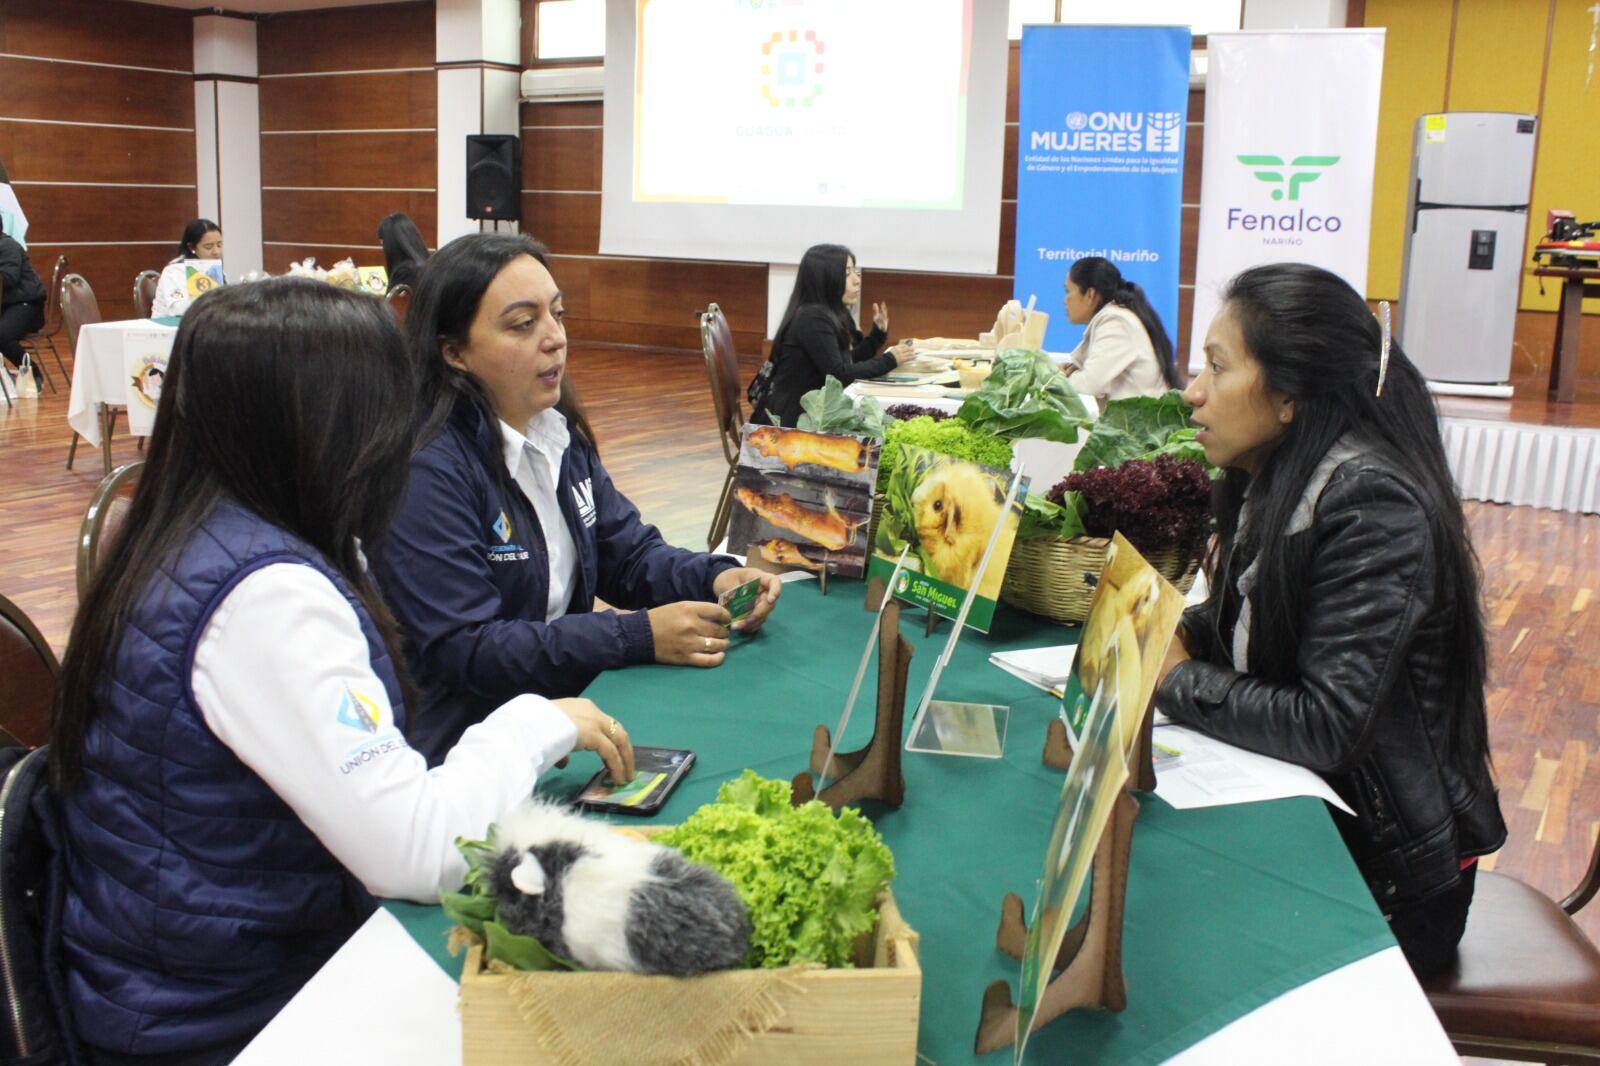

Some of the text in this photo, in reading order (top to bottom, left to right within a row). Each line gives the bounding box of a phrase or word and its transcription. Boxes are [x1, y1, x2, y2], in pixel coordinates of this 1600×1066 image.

[1089, 111, 1143, 131] ONU
[1031, 131, 1143, 151] MUJERES
[1051, 155, 1059, 163] de
[1228, 208, 1340, 232] Fenalco
[1037, 248, 1159, 262] Territorial Nariño
